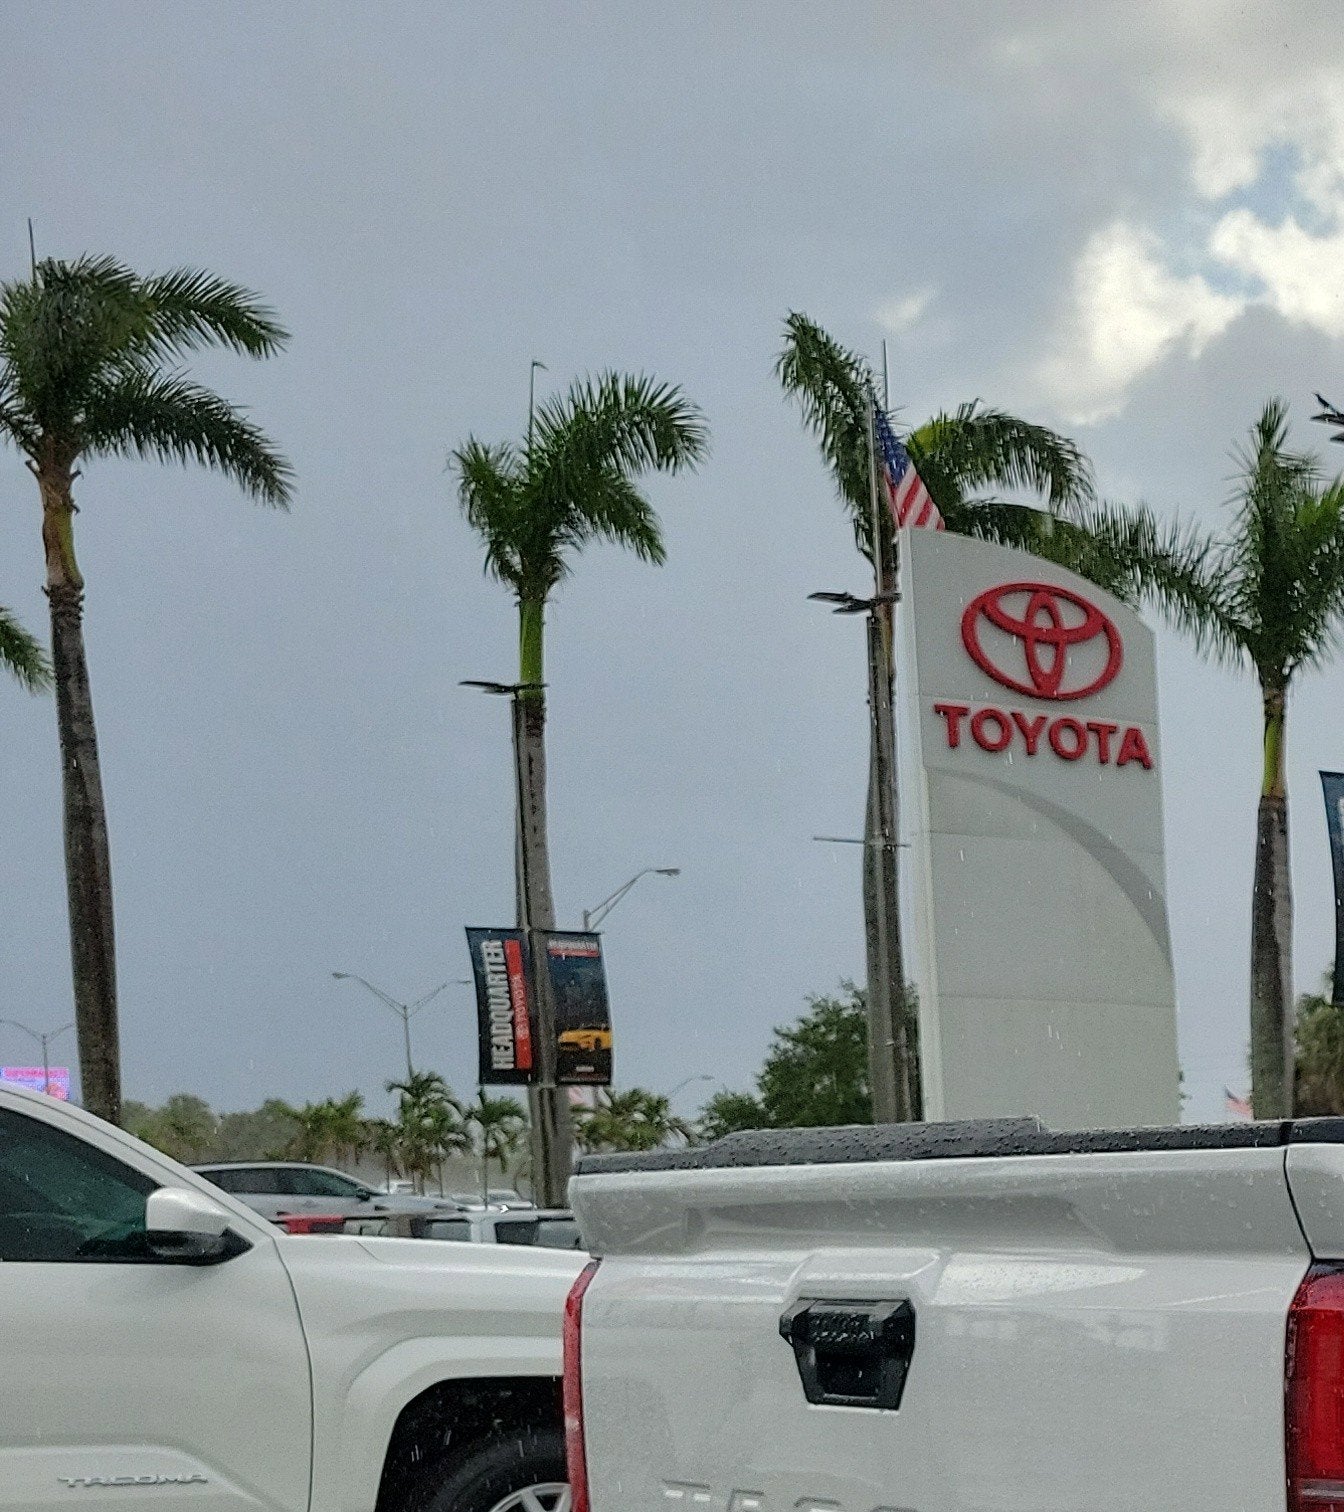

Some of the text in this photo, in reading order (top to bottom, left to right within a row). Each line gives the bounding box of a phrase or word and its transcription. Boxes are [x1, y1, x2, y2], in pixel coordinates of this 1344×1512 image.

[934, 703, 1153, 770] TOYOTA
[481, 939, 515, 1070] HEADQUARTER
[56, 1474, 209, 1489] TACOMA
